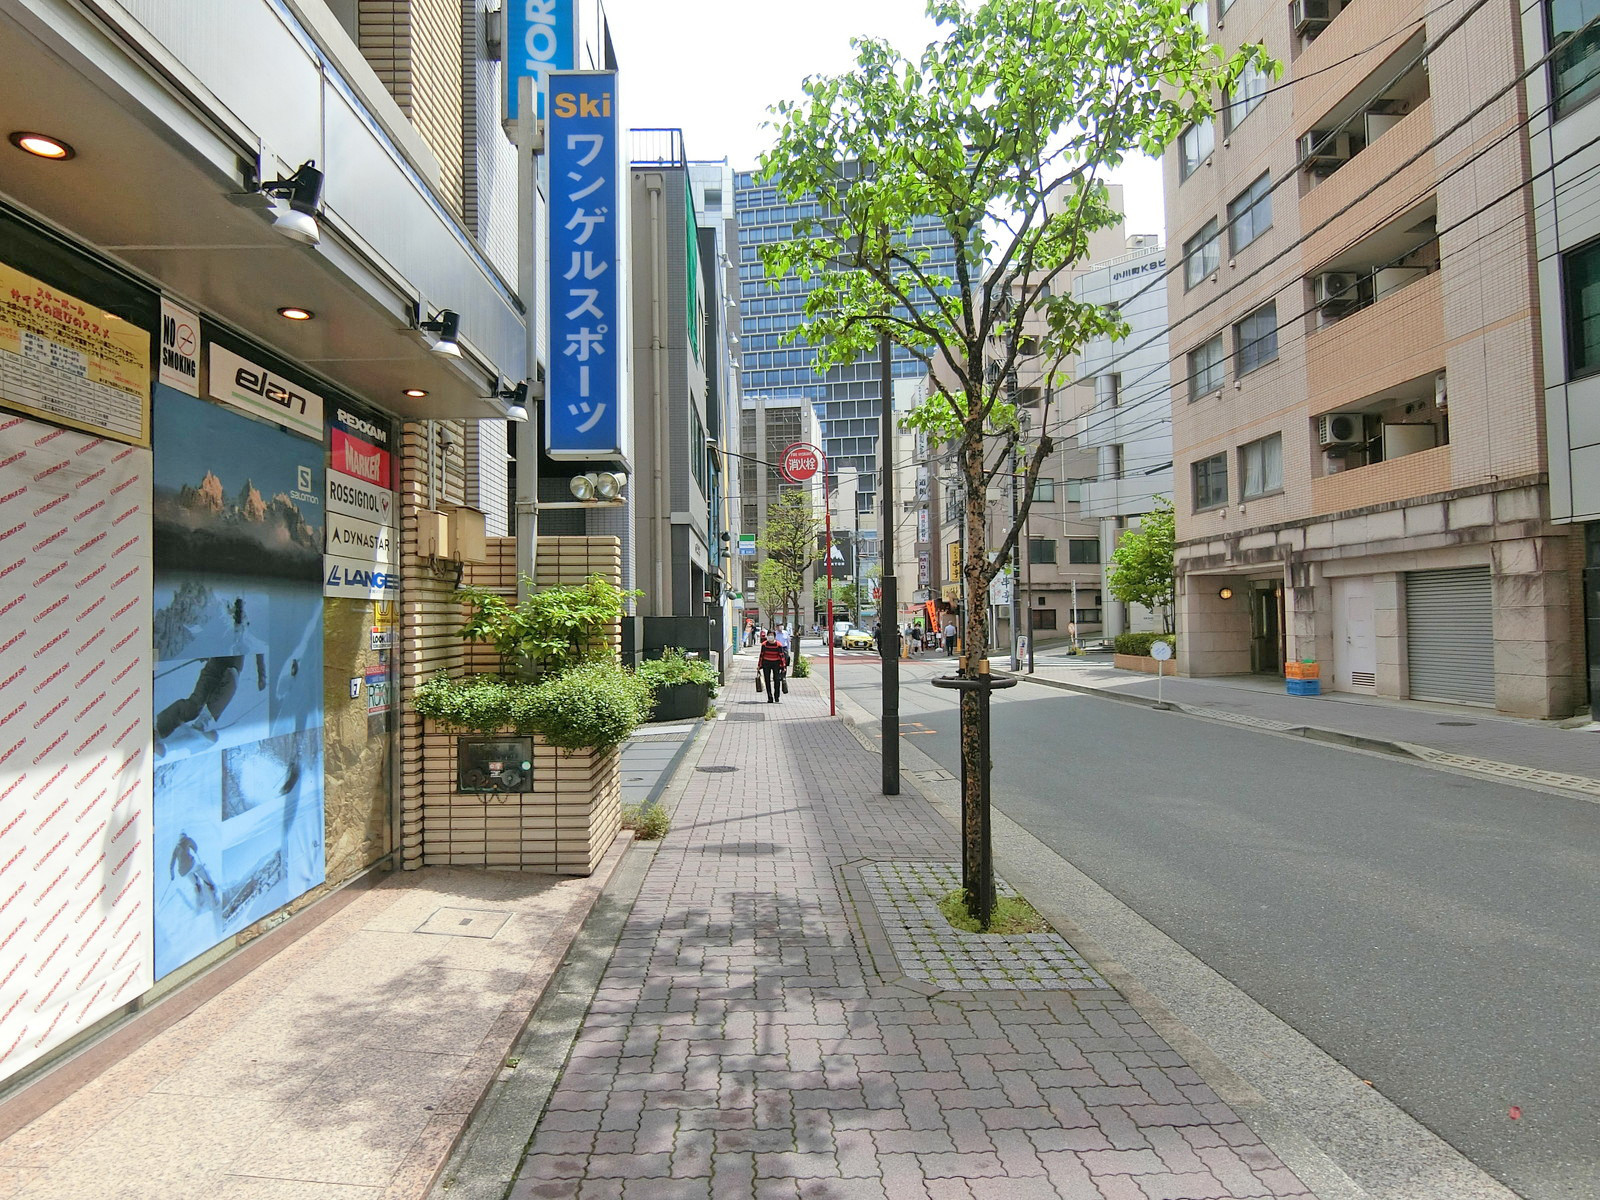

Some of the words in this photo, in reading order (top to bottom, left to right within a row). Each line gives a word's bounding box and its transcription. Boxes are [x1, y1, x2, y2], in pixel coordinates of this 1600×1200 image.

[554, 92, 610, 118] Ski
[562, 133, 608, 433] ワンゲルスポーツ
[164, 314, 176, 346] NO
[162, 346, 196, 378] SMOKING
[234, 367, 307, 414] elan
[337, 408, 386, 443] REXXAM
[344, 438, 381, 482] MARKER
[788, 458, 816, 472] 消火栓
[290, 490, 319, 504] salomon
[330, 481, 379, 512] ROSSIGNOL
[344, 530, 390, 552] DYNASTAR
[344, 568, 398, 590] LANGE
